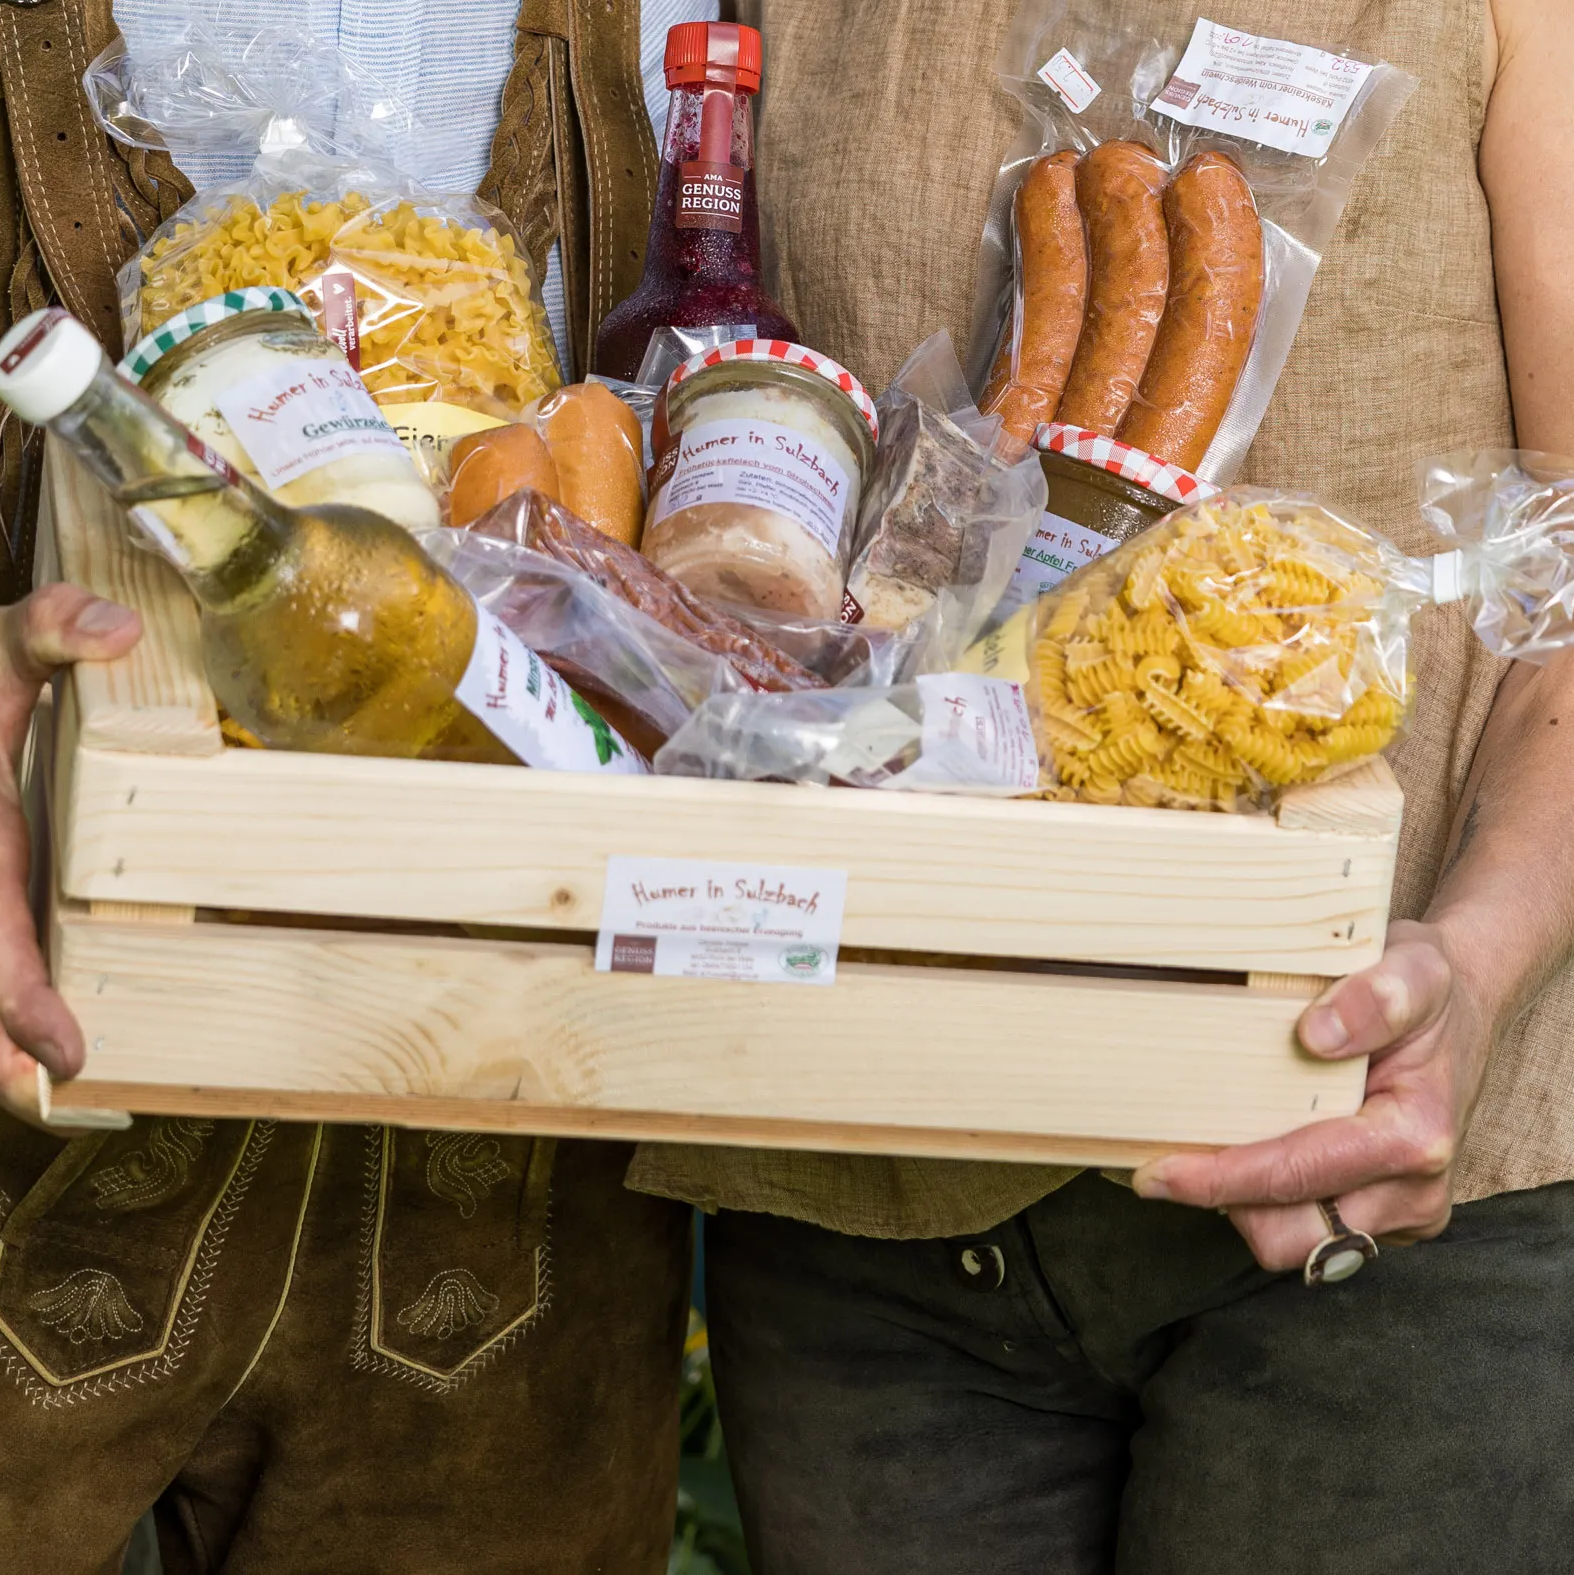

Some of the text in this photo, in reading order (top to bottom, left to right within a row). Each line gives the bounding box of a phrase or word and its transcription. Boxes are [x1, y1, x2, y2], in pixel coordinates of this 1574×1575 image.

[1201, 68, 1258, 89] Weideschwein
[1259, 79, 1277, 91] vom
[1280, 84, 1334, 108] Käsekrainer
[1192, 93, 1248, 121] Sulzbach
[1248, 108, 1261, 123] in
[1264, 111, 1310, 139] Humer
[682, 184, 741, 200] GENUSS
[682, 197, 740, 213] REGION
[345, 295, 356, 350] verarbeitet.
[247, 382, 307, 423] Humer
[308, 373, 329, 389] in
[682, 431, 840, 497] Humer in Sulzbach
[1061, 533, 1073, 548] in
[1036, 550, 1064, 567] Apfel
[485, 646, 509, 710] Humer
[631, 879, 821, 915] Humer in Sulzbach
[614, 946, 654, 955] GENUSS
[614, 955, 652, 964] REGION
